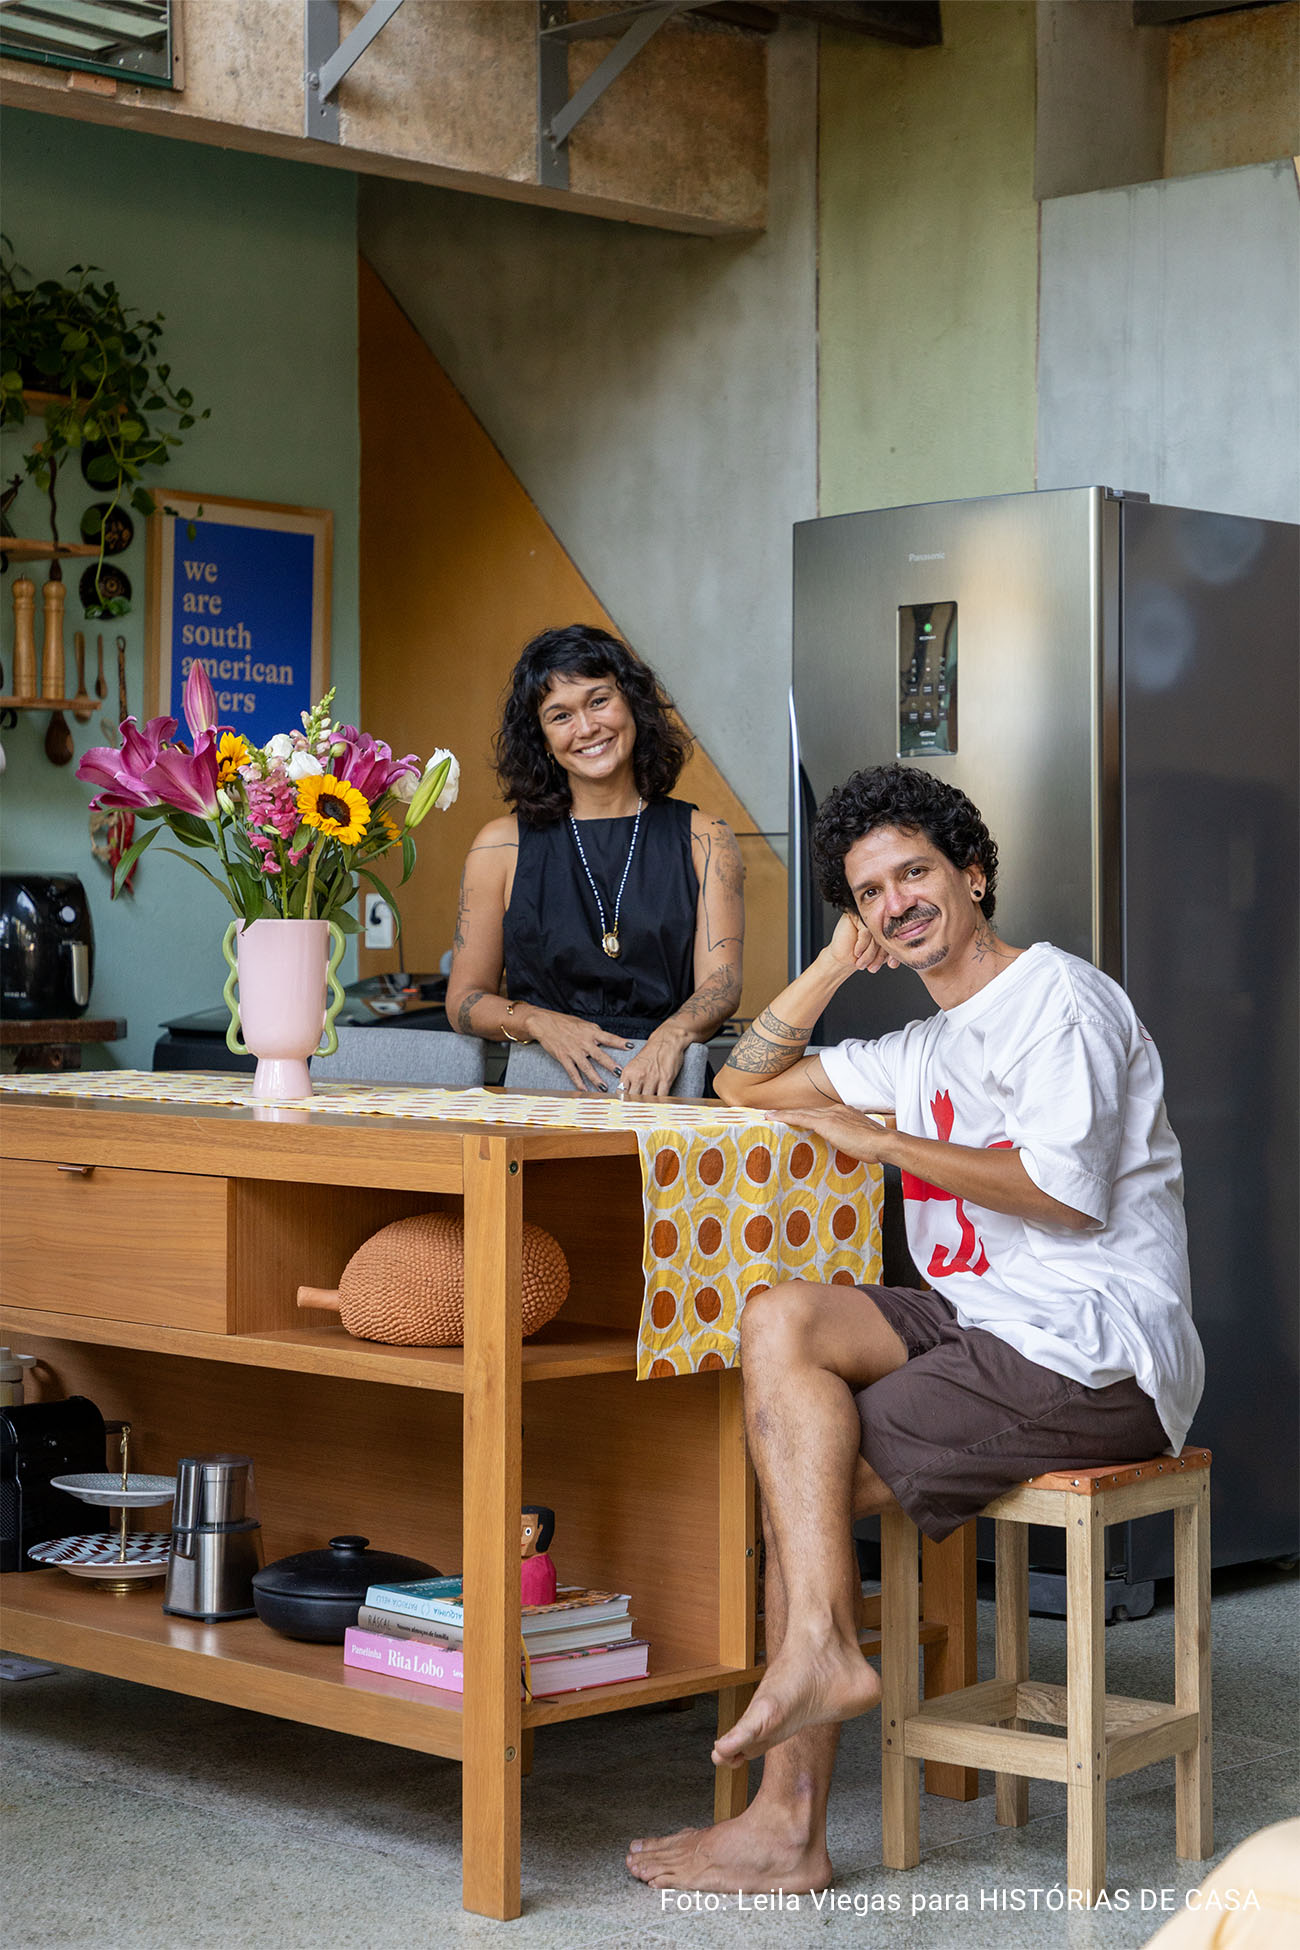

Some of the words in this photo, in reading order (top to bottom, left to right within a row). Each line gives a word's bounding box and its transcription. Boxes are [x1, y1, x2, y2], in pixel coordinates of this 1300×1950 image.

[908, 552, 945, 562] Panasonic
[183, 560, 218, 583] we
[183, 592, 222, 615] are
[182, 622, 252, 649] south
[181, 654, 294, 686] american
[351, 1644, 382, 1660] Panelinha
[387, 1649, 412, 1671] Rita
[413, 1655, 444, 1679] Lobo
